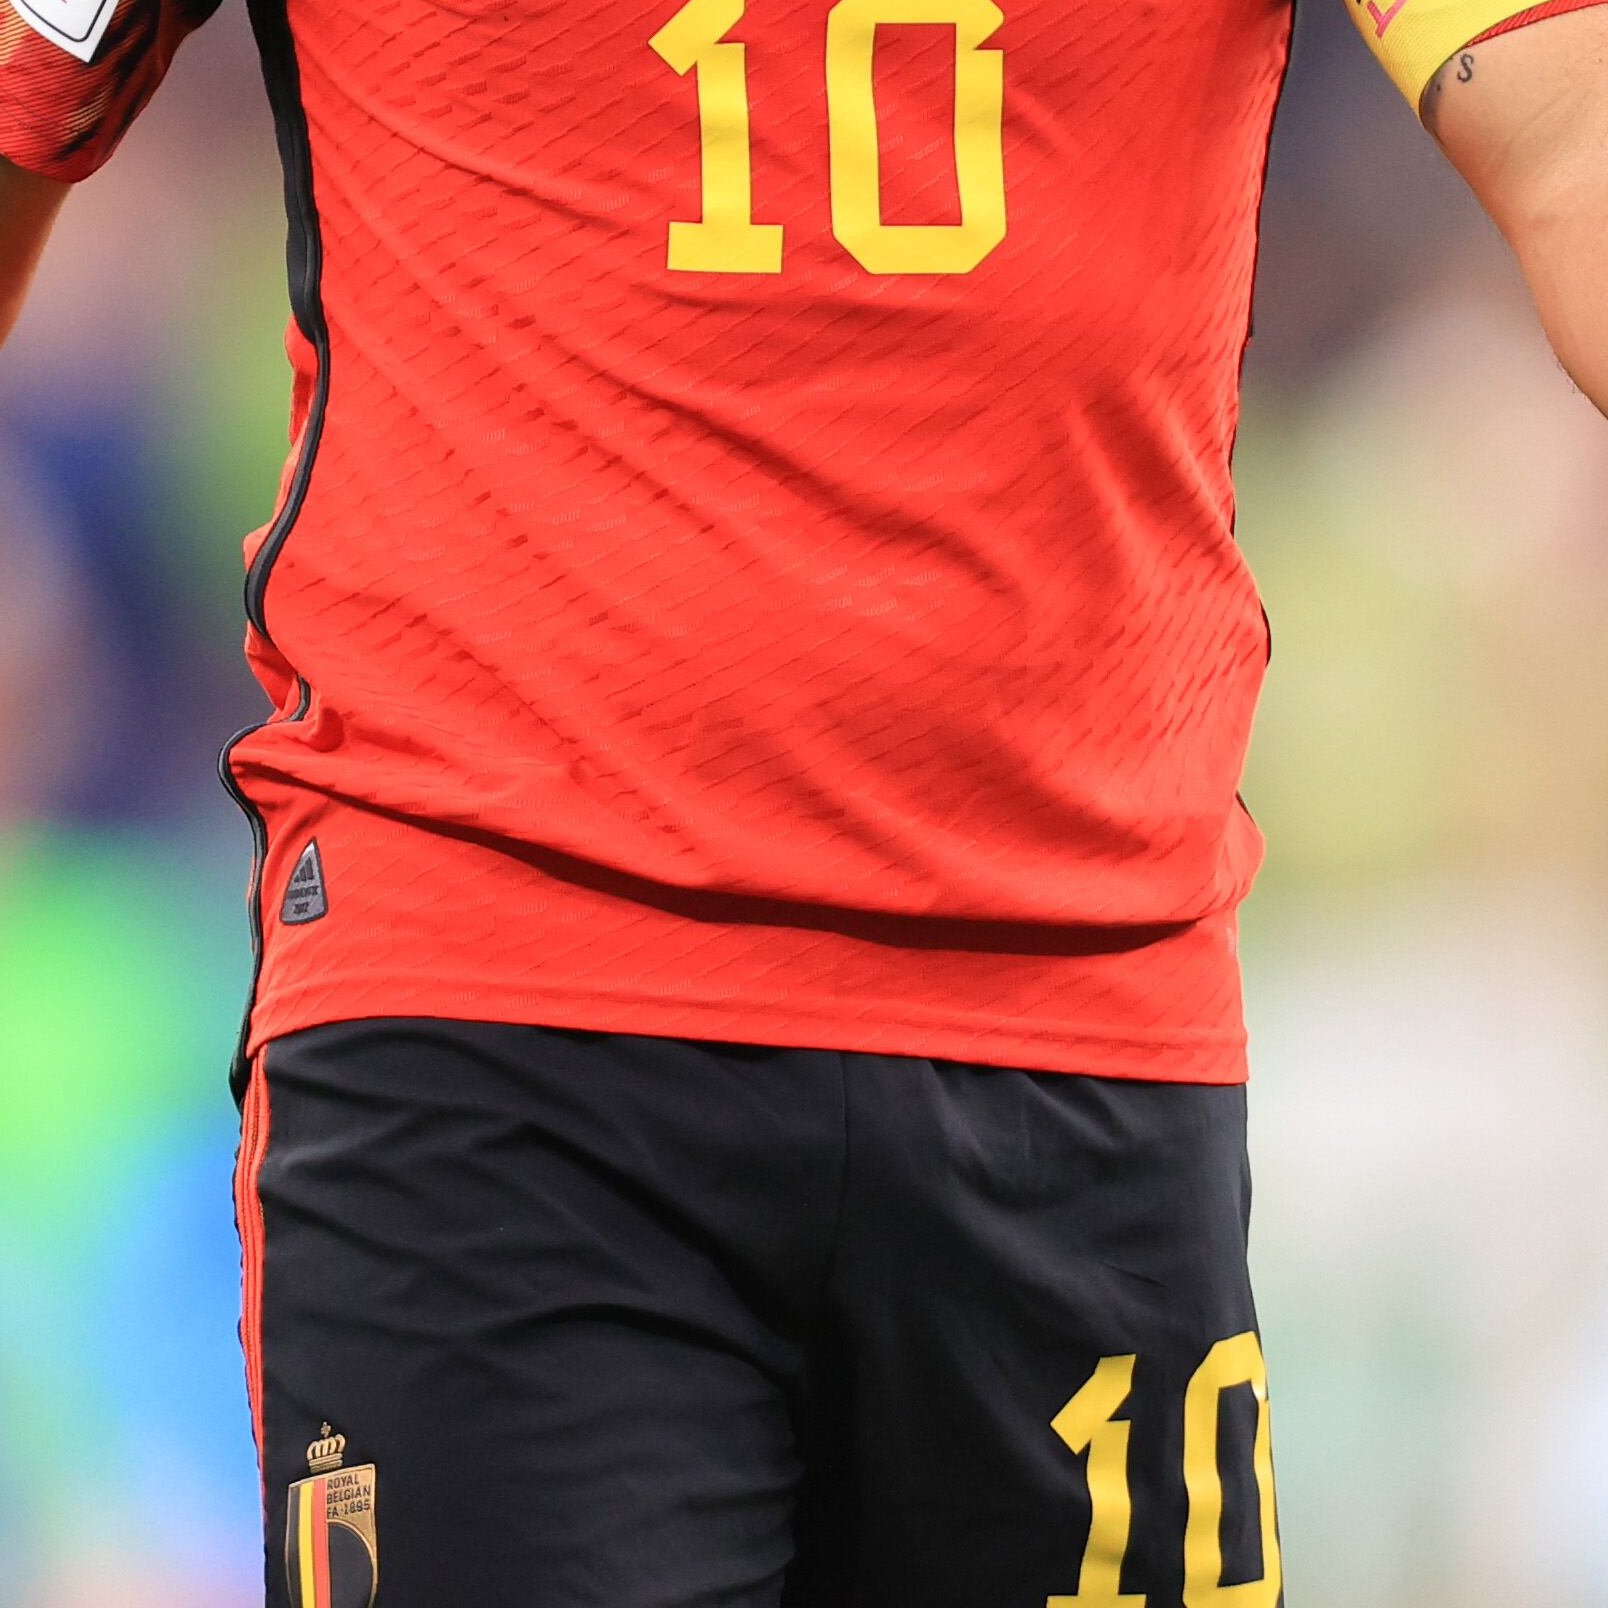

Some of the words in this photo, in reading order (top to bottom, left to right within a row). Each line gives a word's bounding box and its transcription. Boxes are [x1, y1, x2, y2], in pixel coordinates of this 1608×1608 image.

[1046, 1330, 1282, 1608] 10
[327, 1474, 360, 1490] ROYAL
[326, 1485, 371, 1505] BELGIAN
